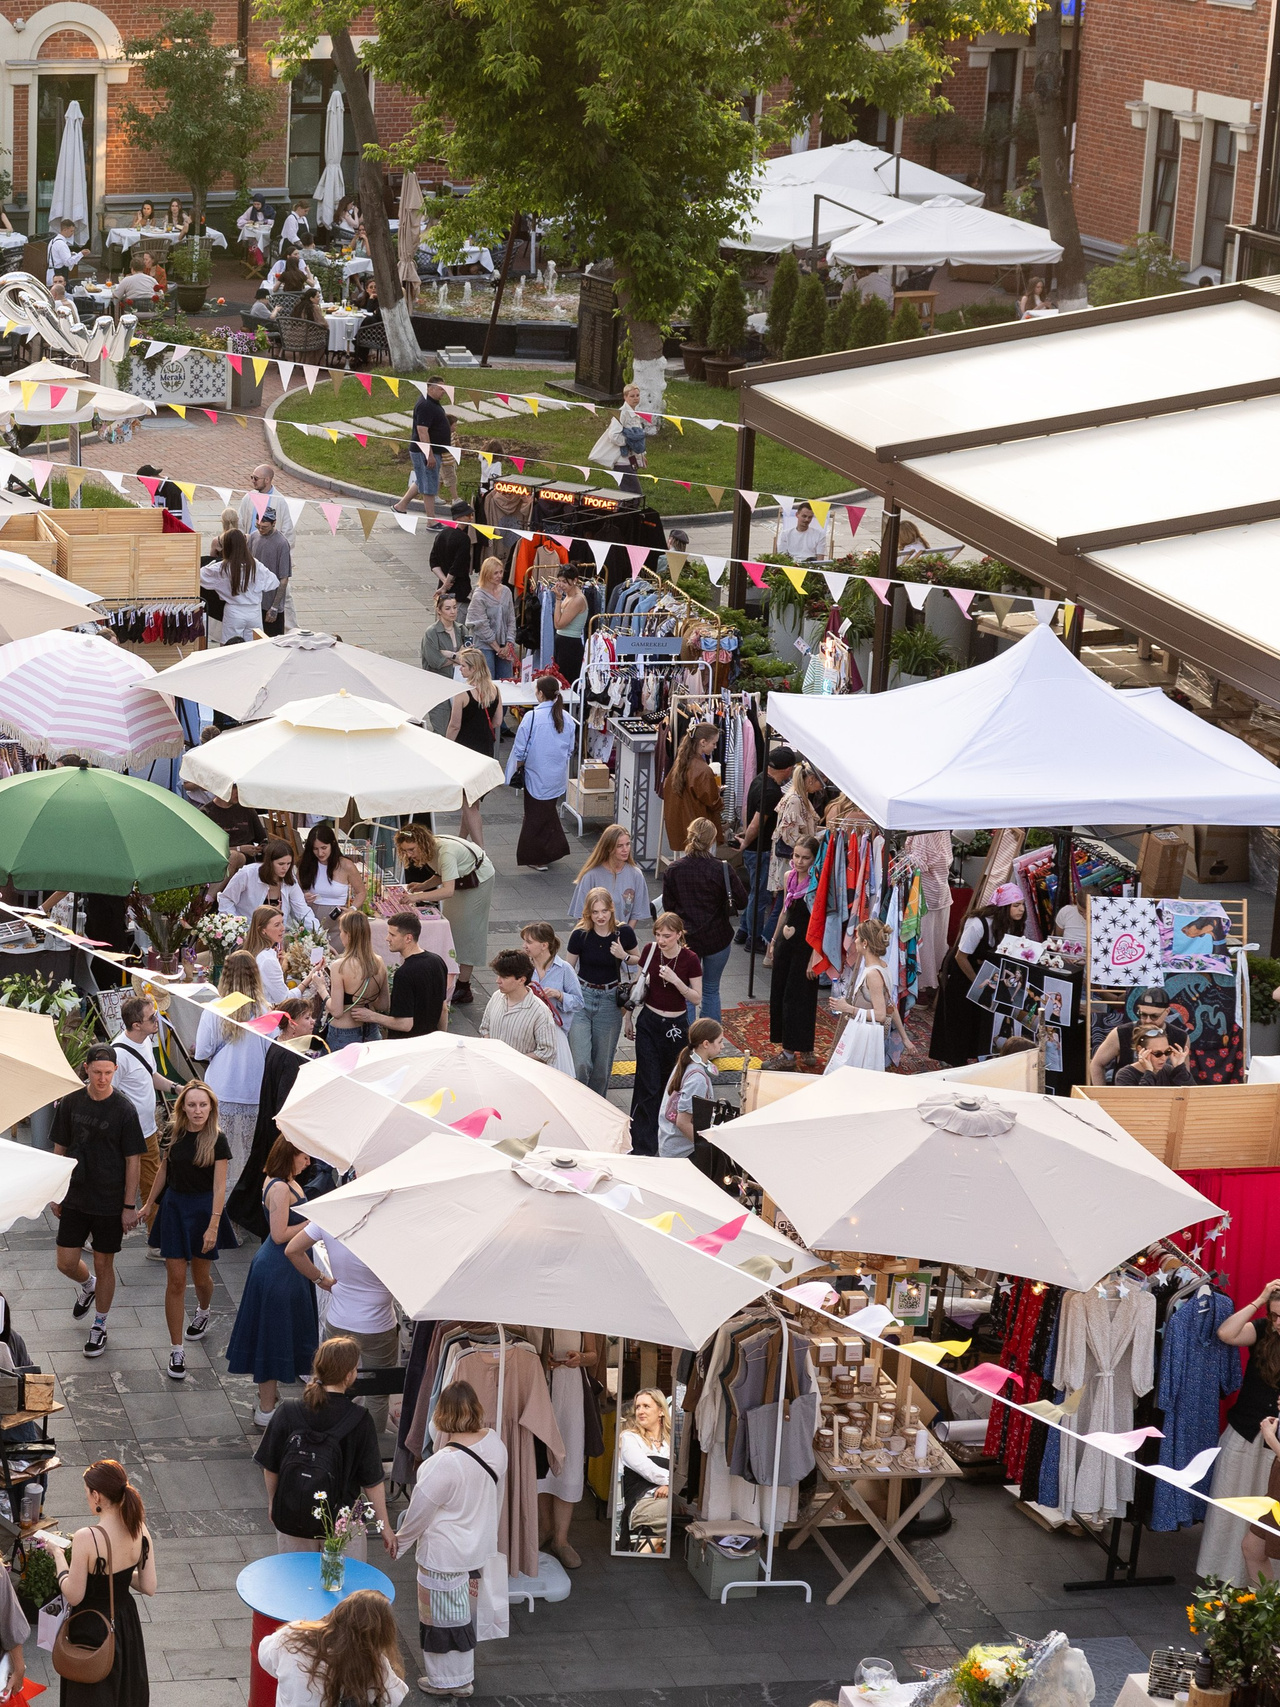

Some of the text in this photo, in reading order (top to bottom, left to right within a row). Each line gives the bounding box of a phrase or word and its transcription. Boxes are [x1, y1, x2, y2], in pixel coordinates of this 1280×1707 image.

[160, 372, 186, 382] Meraki
[495, 482, 530, 496] ОДЕЖДА,
[539, 490, 574, 503] КОТОРАЯ
